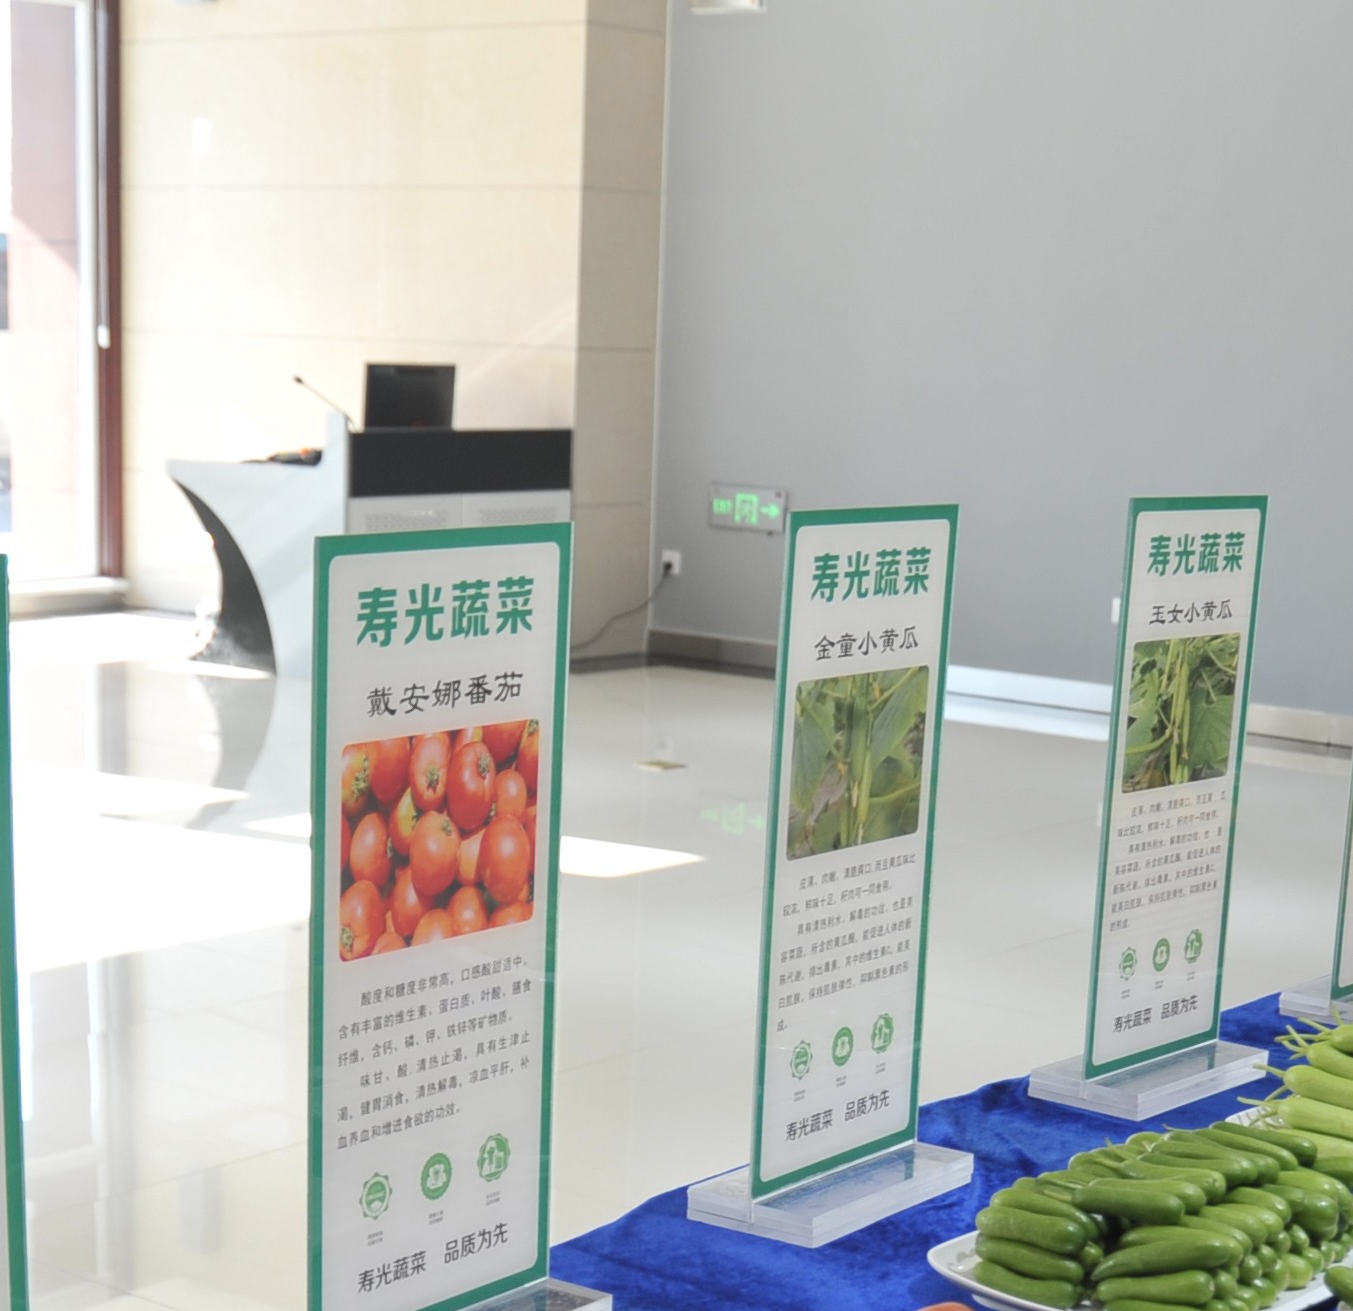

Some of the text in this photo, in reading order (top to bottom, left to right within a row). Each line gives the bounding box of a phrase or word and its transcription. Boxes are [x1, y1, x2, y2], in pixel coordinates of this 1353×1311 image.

[811, 546, 931, 603] 寿光蔬菜
[1148, 531, 1245, 576] 寿光蔬菜
[356, 575, 534, 648] 寿光蔬菜
[1149, 599, 1232, 625] 玉女小黄瓜
[814, 626, 918, 661] 金童小黄瓜
[366, 671, 523, 718] 戴安娜番茄
[1113, 995, 1198, 1033] 寿光蔬菜 品质为先
[785, 1090, 890, 1142] 寿光蔬菜 品质为先
[358, 1223, 508, 1294] 寿光蔬菜 品质为先
